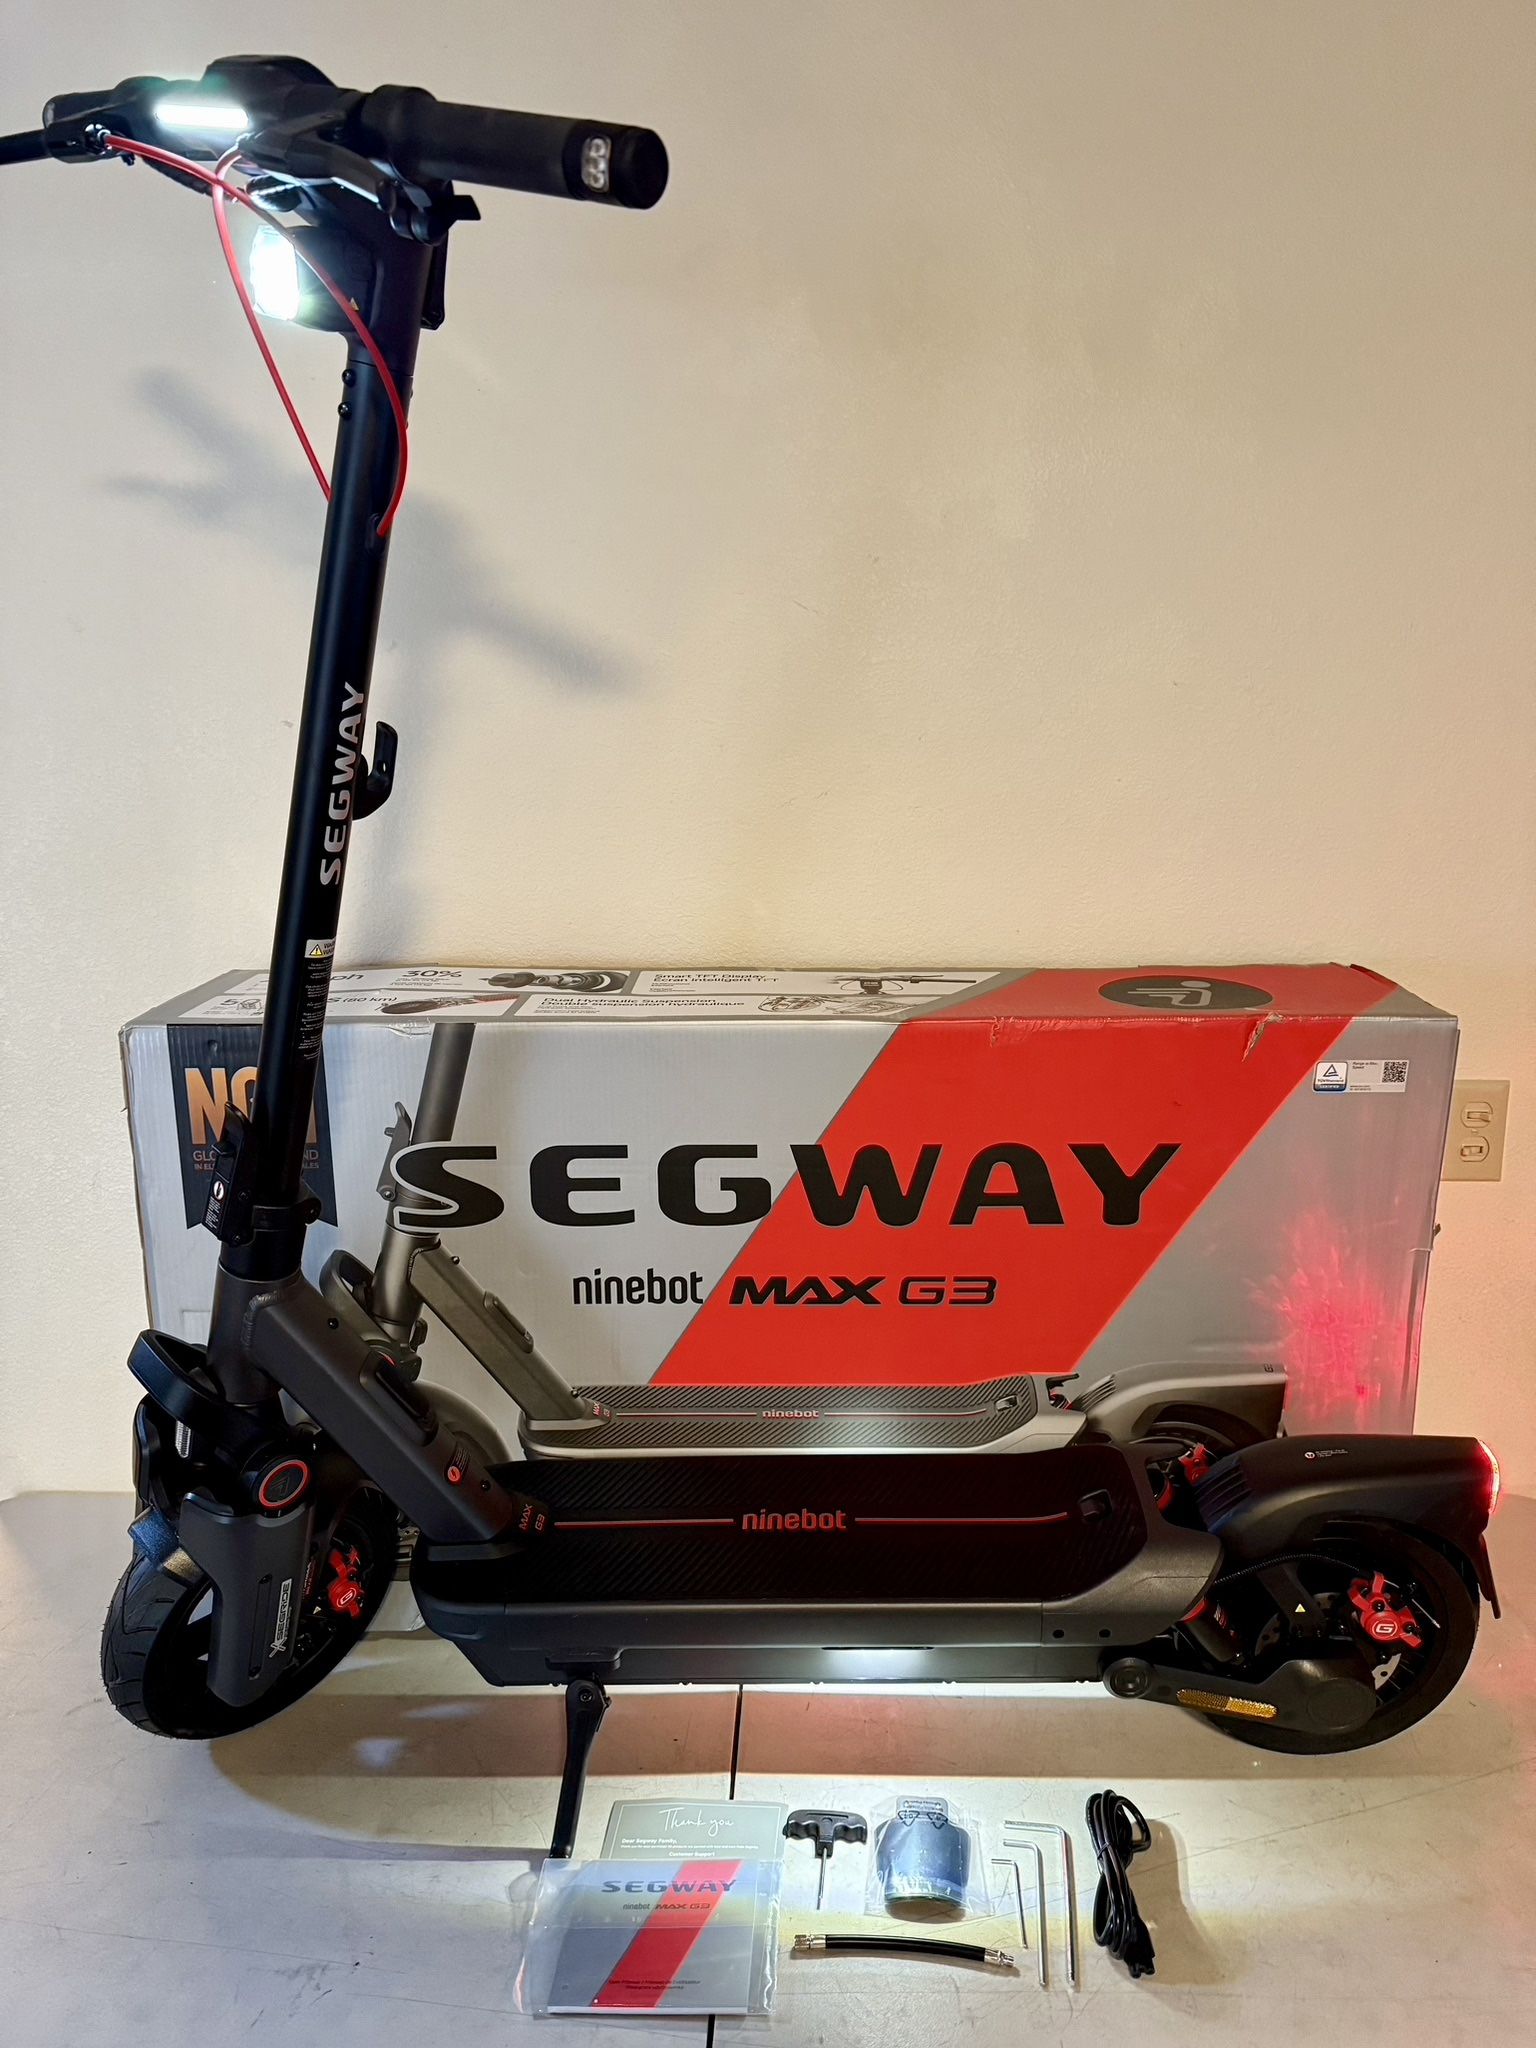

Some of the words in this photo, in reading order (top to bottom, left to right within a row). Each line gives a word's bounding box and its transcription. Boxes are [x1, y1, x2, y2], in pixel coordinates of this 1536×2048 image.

[320, 682, 364, 885] SEGWAY
[330, 973, 365, 982] ph
[401, 969, 463, 979] 30%
[192, 1150, 217, 1162] GLO
[396, 1142, 1182, 1228] SEGWAY
[572, 1268, 704, 1305] ninebot
[729, 1275, 885, 1306] MAX
[898, 1275, 998, 1306] G3
[761, 1409, 820, 1419] ninebot
[518, 1503, 535, 1531] MAX
[534, 1513, 546, 1532] G3
[741, 1507, 847, 1532] ninebot
[659, 1806, 707, 1832] Thank
[708, 1818, 735, 1838] you
[601, 1879, 737, 1893] SEGWAY
